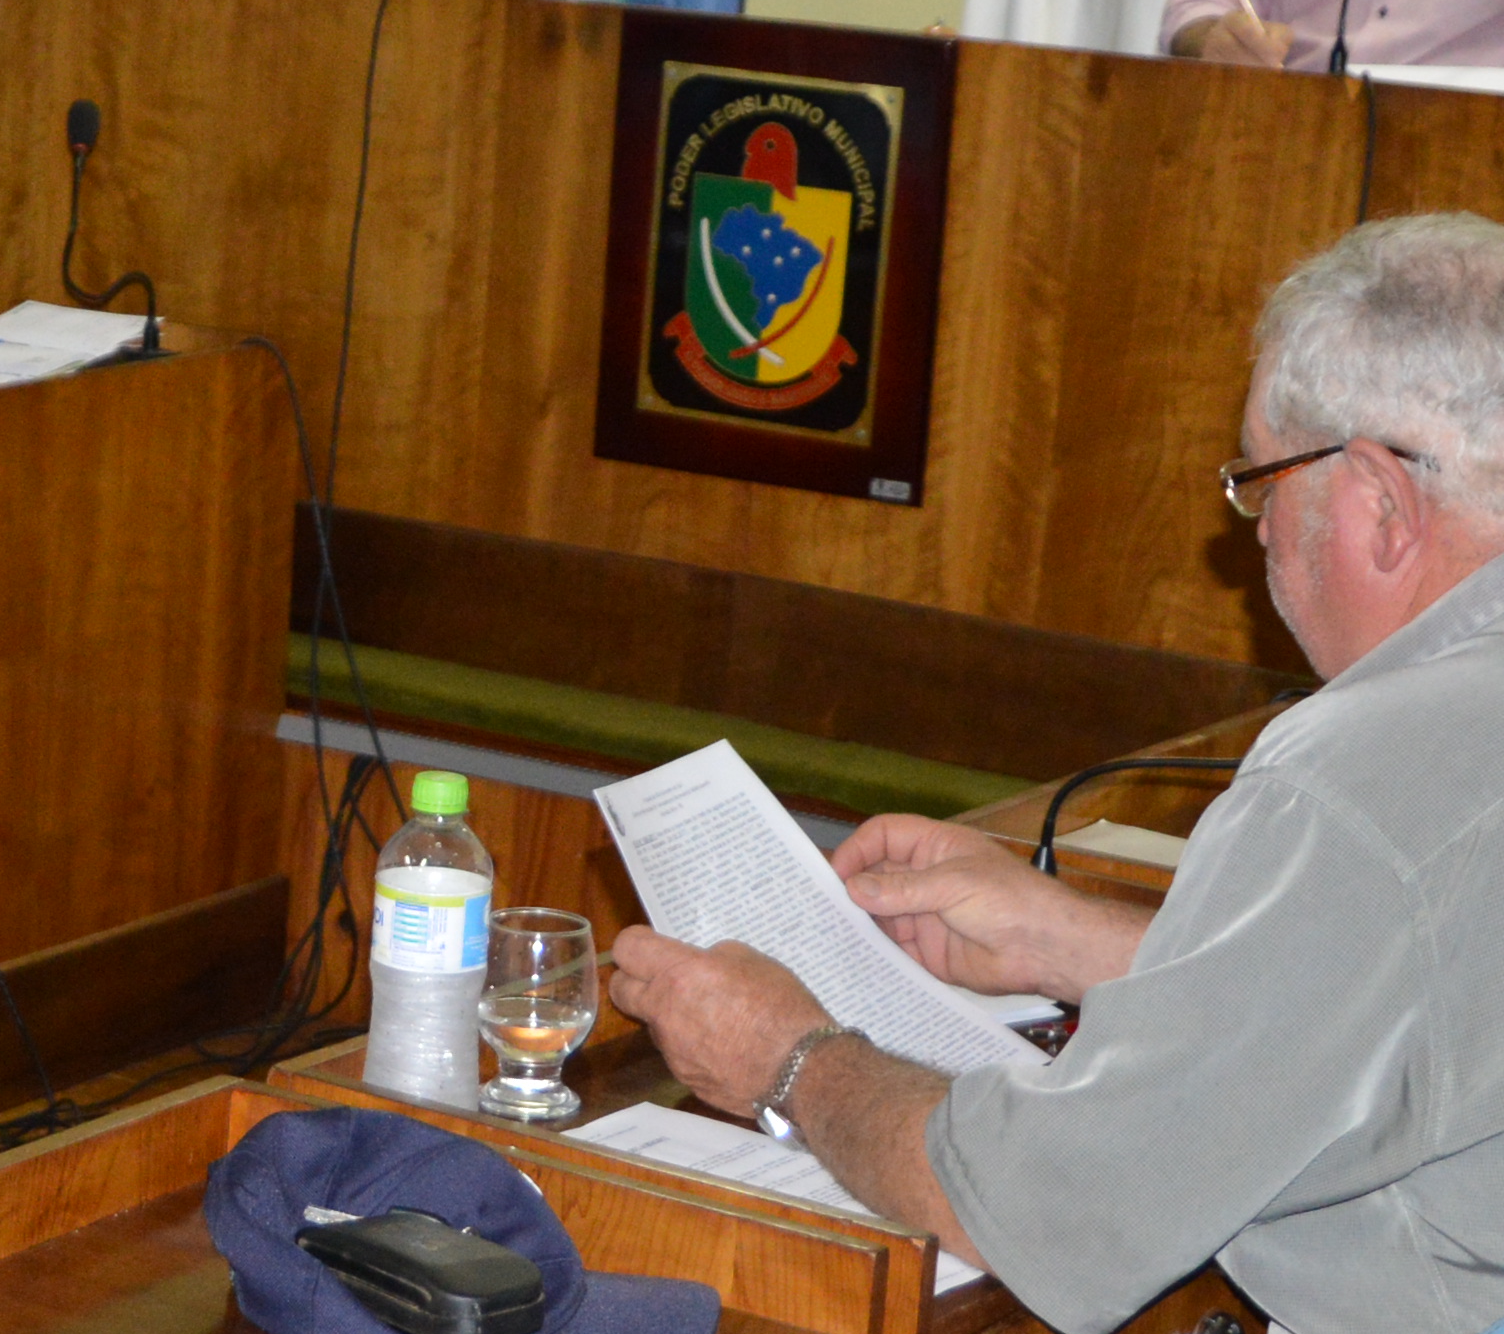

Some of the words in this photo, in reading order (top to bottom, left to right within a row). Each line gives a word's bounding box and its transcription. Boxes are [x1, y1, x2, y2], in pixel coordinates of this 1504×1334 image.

[668, 133, 705, 207] PODER
[700, 93, 825, 137] LEGISLATIVO
[823, 118, 876, 232] MUNICIPAL
